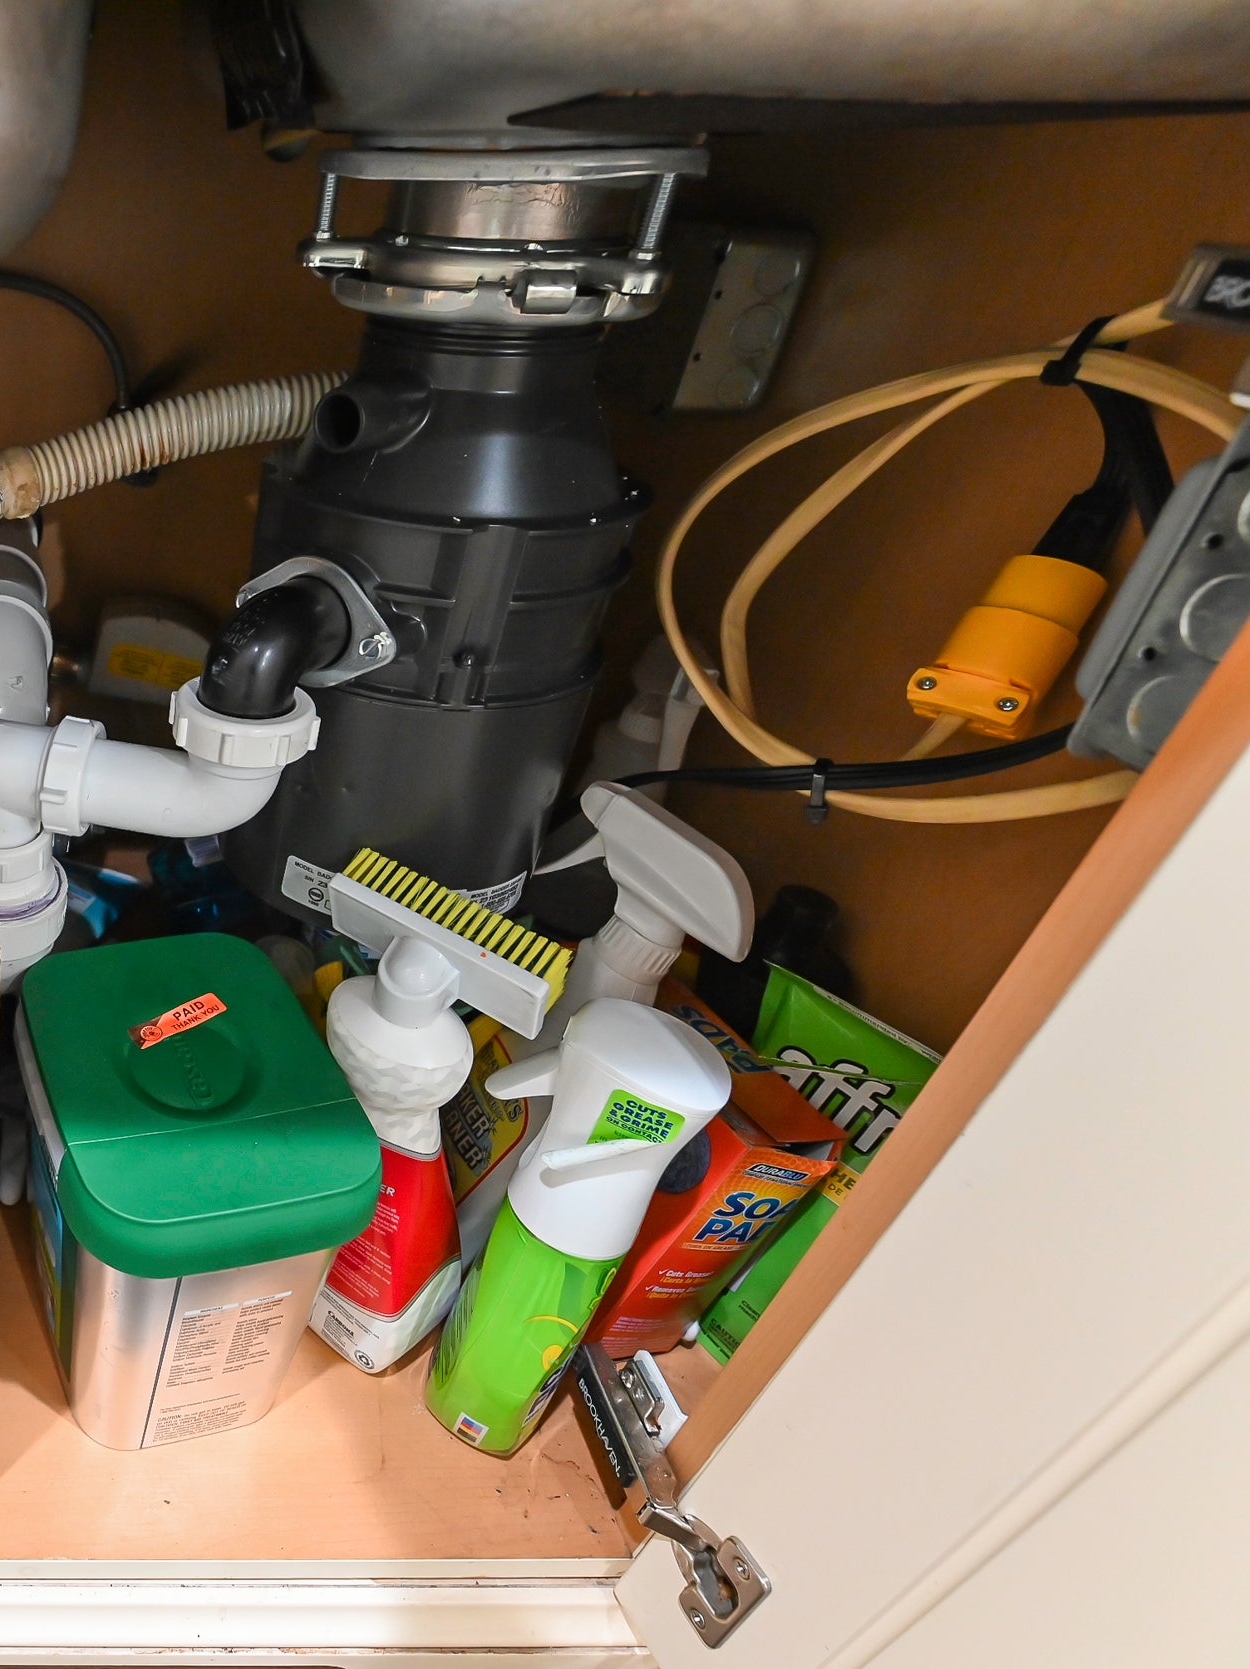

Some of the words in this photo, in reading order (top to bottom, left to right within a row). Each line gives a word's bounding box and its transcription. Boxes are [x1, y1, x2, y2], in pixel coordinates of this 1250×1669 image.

[295, 861, 314, 873] MODEL
[171, 1016, 201, 1031] THANK
[201, 1005, 220, 1017] YOU
[173, 1001, 205, 1021] PAID
[613, 1102, 674, 1130] GREASE
[626, 1100, 667, 1119] CUTS
[606, 1116, 619, 1125] ON
[610, 1109, 618, 1118] &
[621, 1115, 669, 1139] GRIME
[754, 1165, 805, 1180] DURABLU
[578, 1378, 620, 1478] BROOKHAVEN
